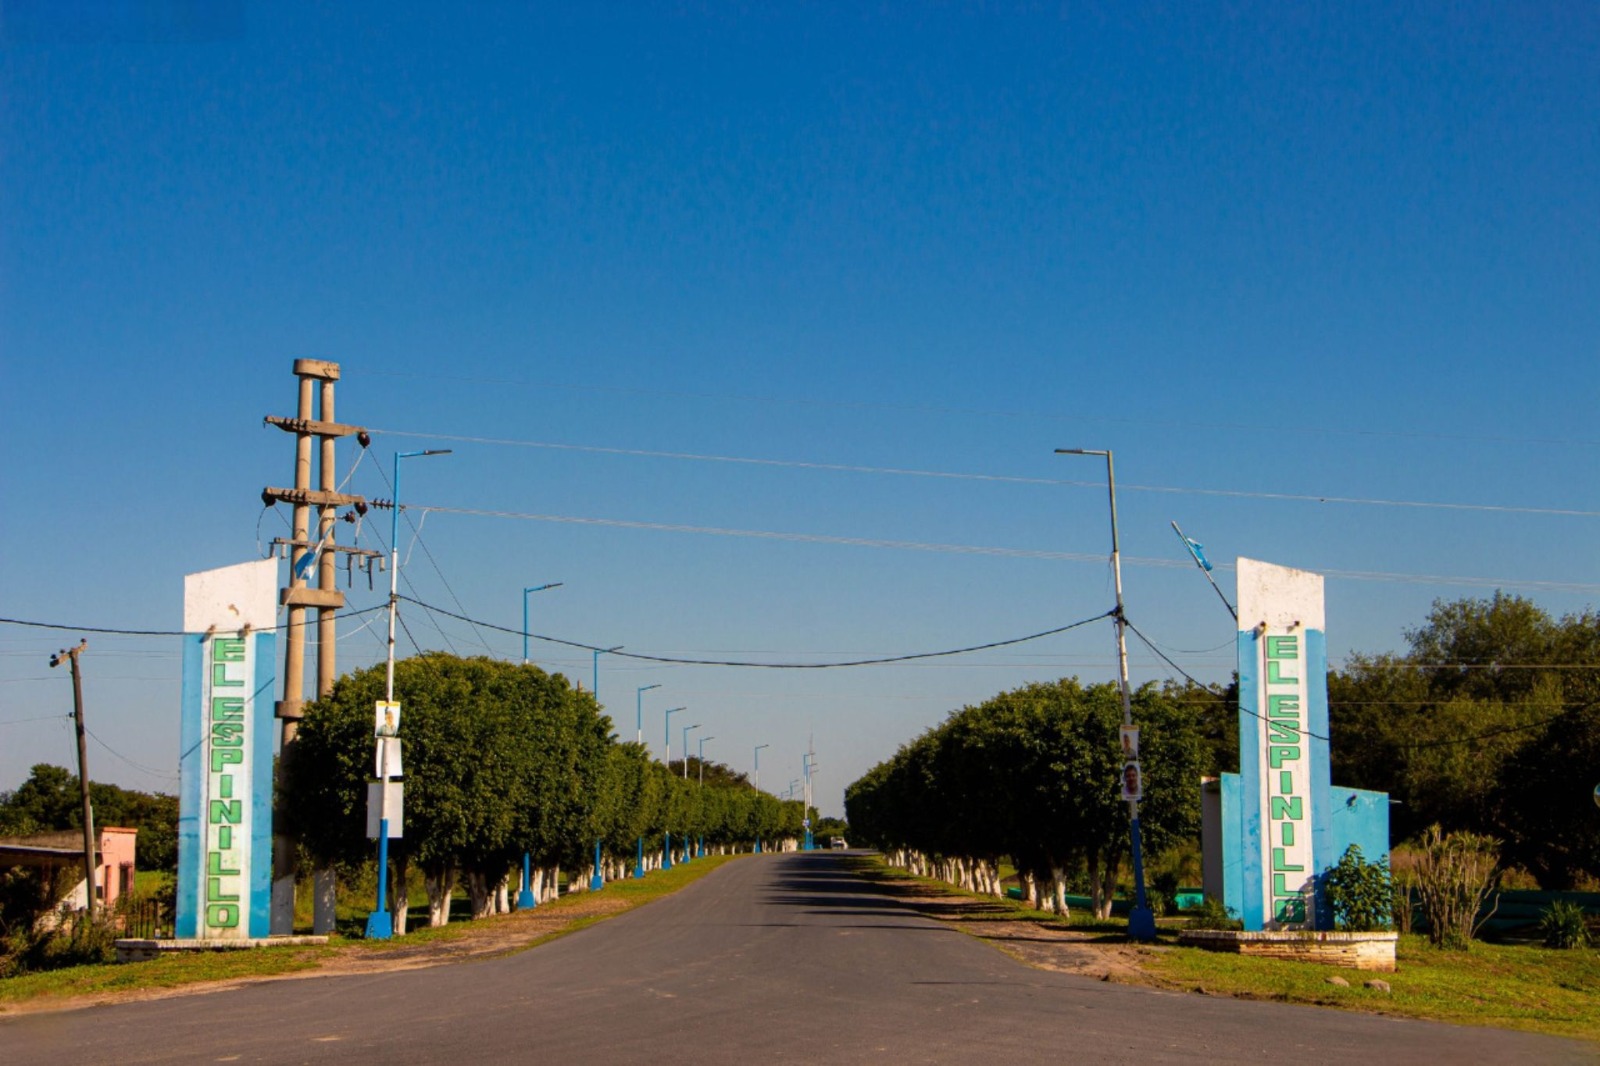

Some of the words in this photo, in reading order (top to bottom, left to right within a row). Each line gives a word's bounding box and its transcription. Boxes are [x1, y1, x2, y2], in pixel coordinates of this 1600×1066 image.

[213, 637, 246, 687] EL
[1266, 636, 1298, 685] EL
[207, 697, 244, 928] ESPINILLO
[1268, 695, 1306, 922] ESPINILLO
